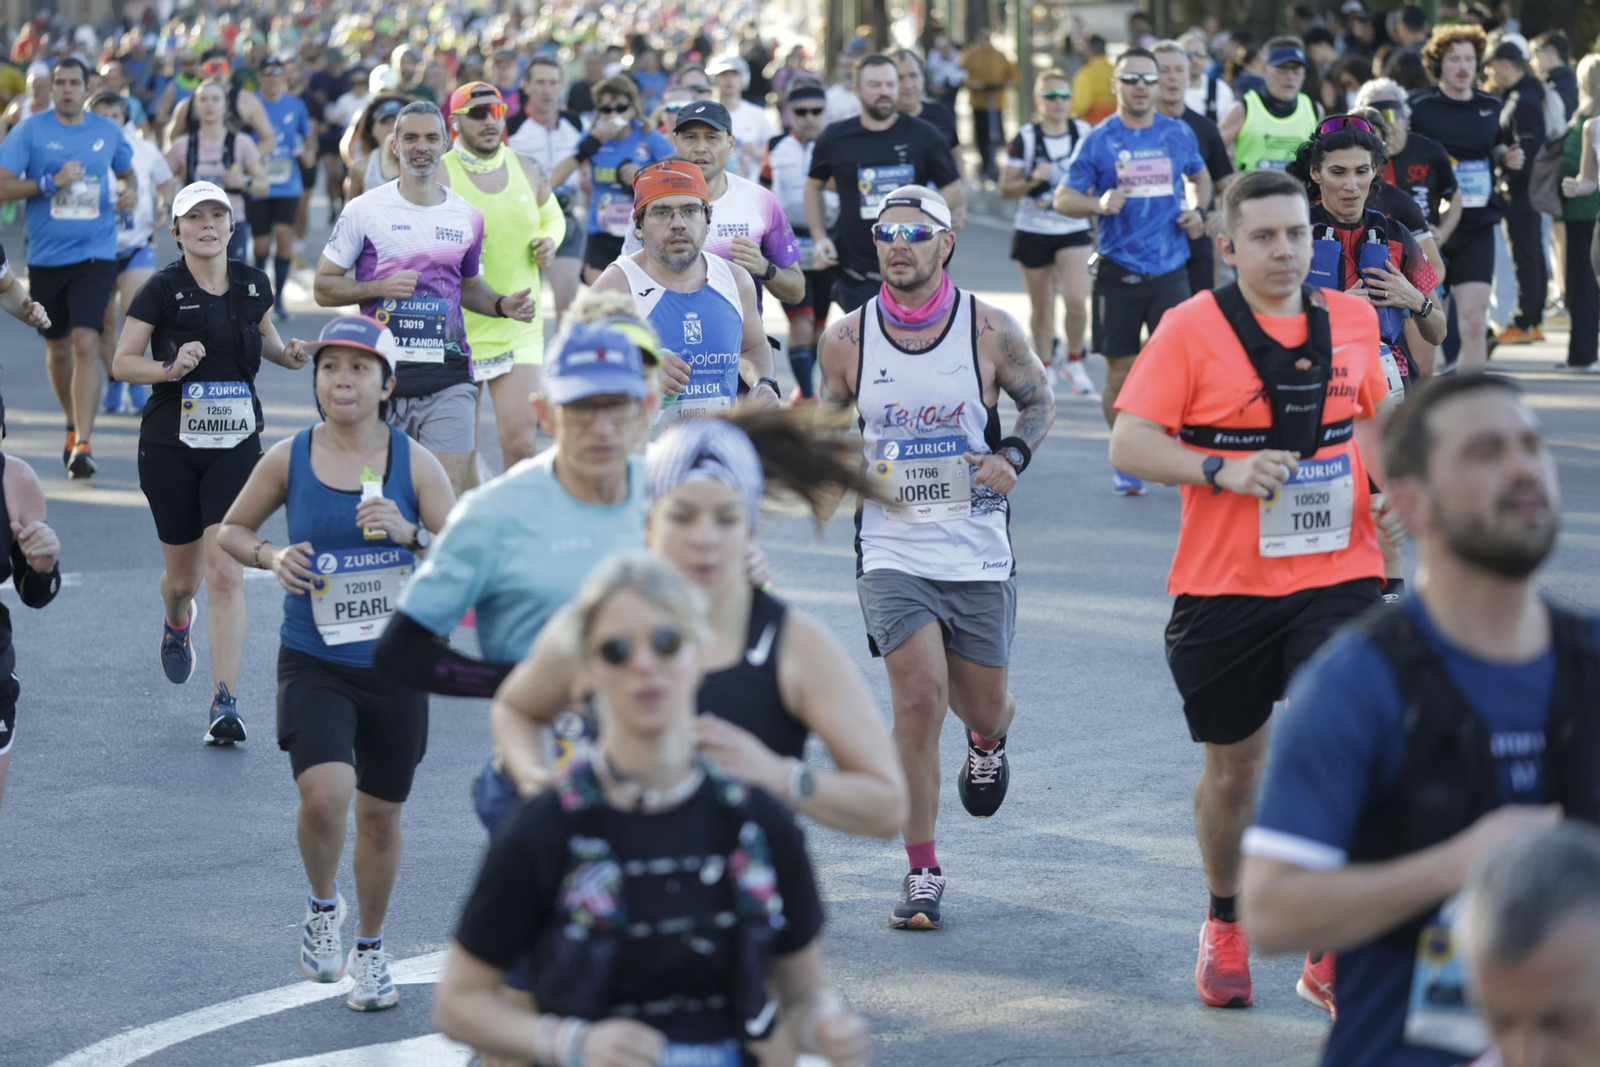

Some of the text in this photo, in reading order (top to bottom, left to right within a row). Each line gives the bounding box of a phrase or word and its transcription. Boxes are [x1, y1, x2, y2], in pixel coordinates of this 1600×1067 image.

[435, 226, 464, 235] RUNNING
[401, 301, 440, 311] ZURICH
[398, 319, 425, 330] 13019
[401, 336, 408, 347] Y
[409, 337, 444, 348] SANDRA
[208, 386, 246, 396] ZURICH
[206, 406, 232, 415] 12595
[188, 418, 249, 432] CAMILLA
[905, 441, 957, 456] ZURICH
[905, 467, 938, 480] 11766
[1296, 460, 1343, 480] ZURICH
[895, 483, 951, 503] JORGE
[1294, 492, 1330, 507] 10520
[1291, 509, 1331, 531] TOM
[344, 550, 400, 568] ZURICH
[345, 580, 382, 595] 12010
[335, 596, 394, 620] PEARL
